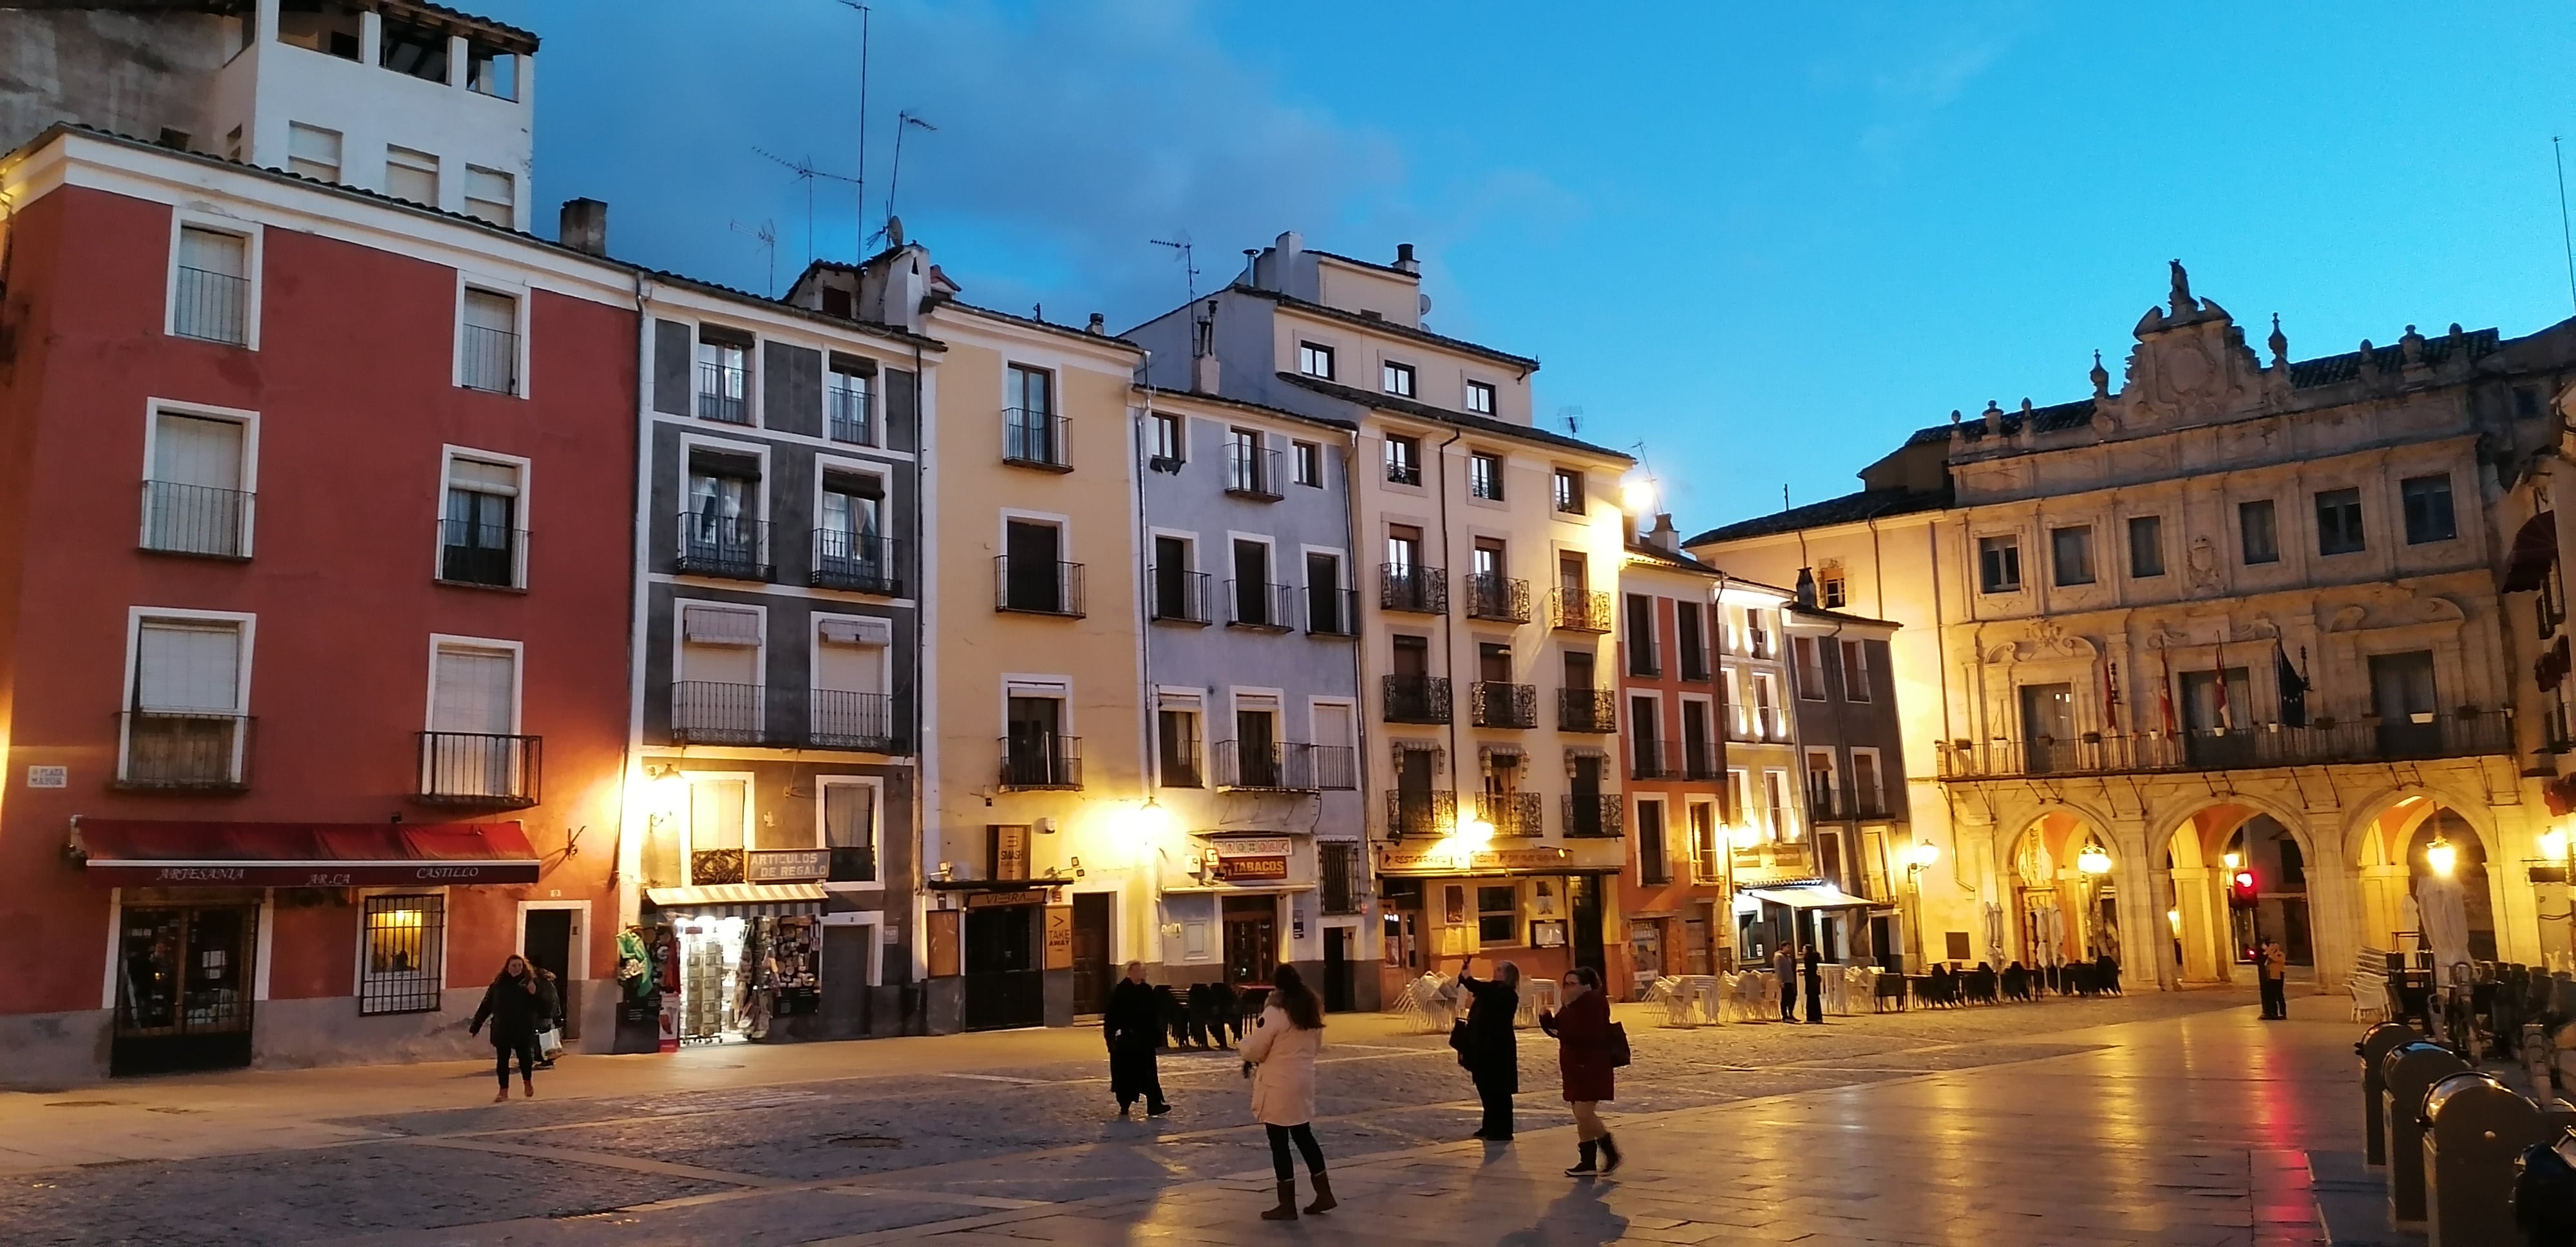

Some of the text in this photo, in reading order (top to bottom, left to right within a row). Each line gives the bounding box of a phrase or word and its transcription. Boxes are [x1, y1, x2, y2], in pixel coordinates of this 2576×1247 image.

[750, 853, 818, 864] ARTICULOS
[416, 867, 478, 879] CASTILLO
[761, 865, 826, 877] DE REGALO
[1233, 861, 1285, 873] TABACOS
[1048, 929, 1070, 939] TAKE
